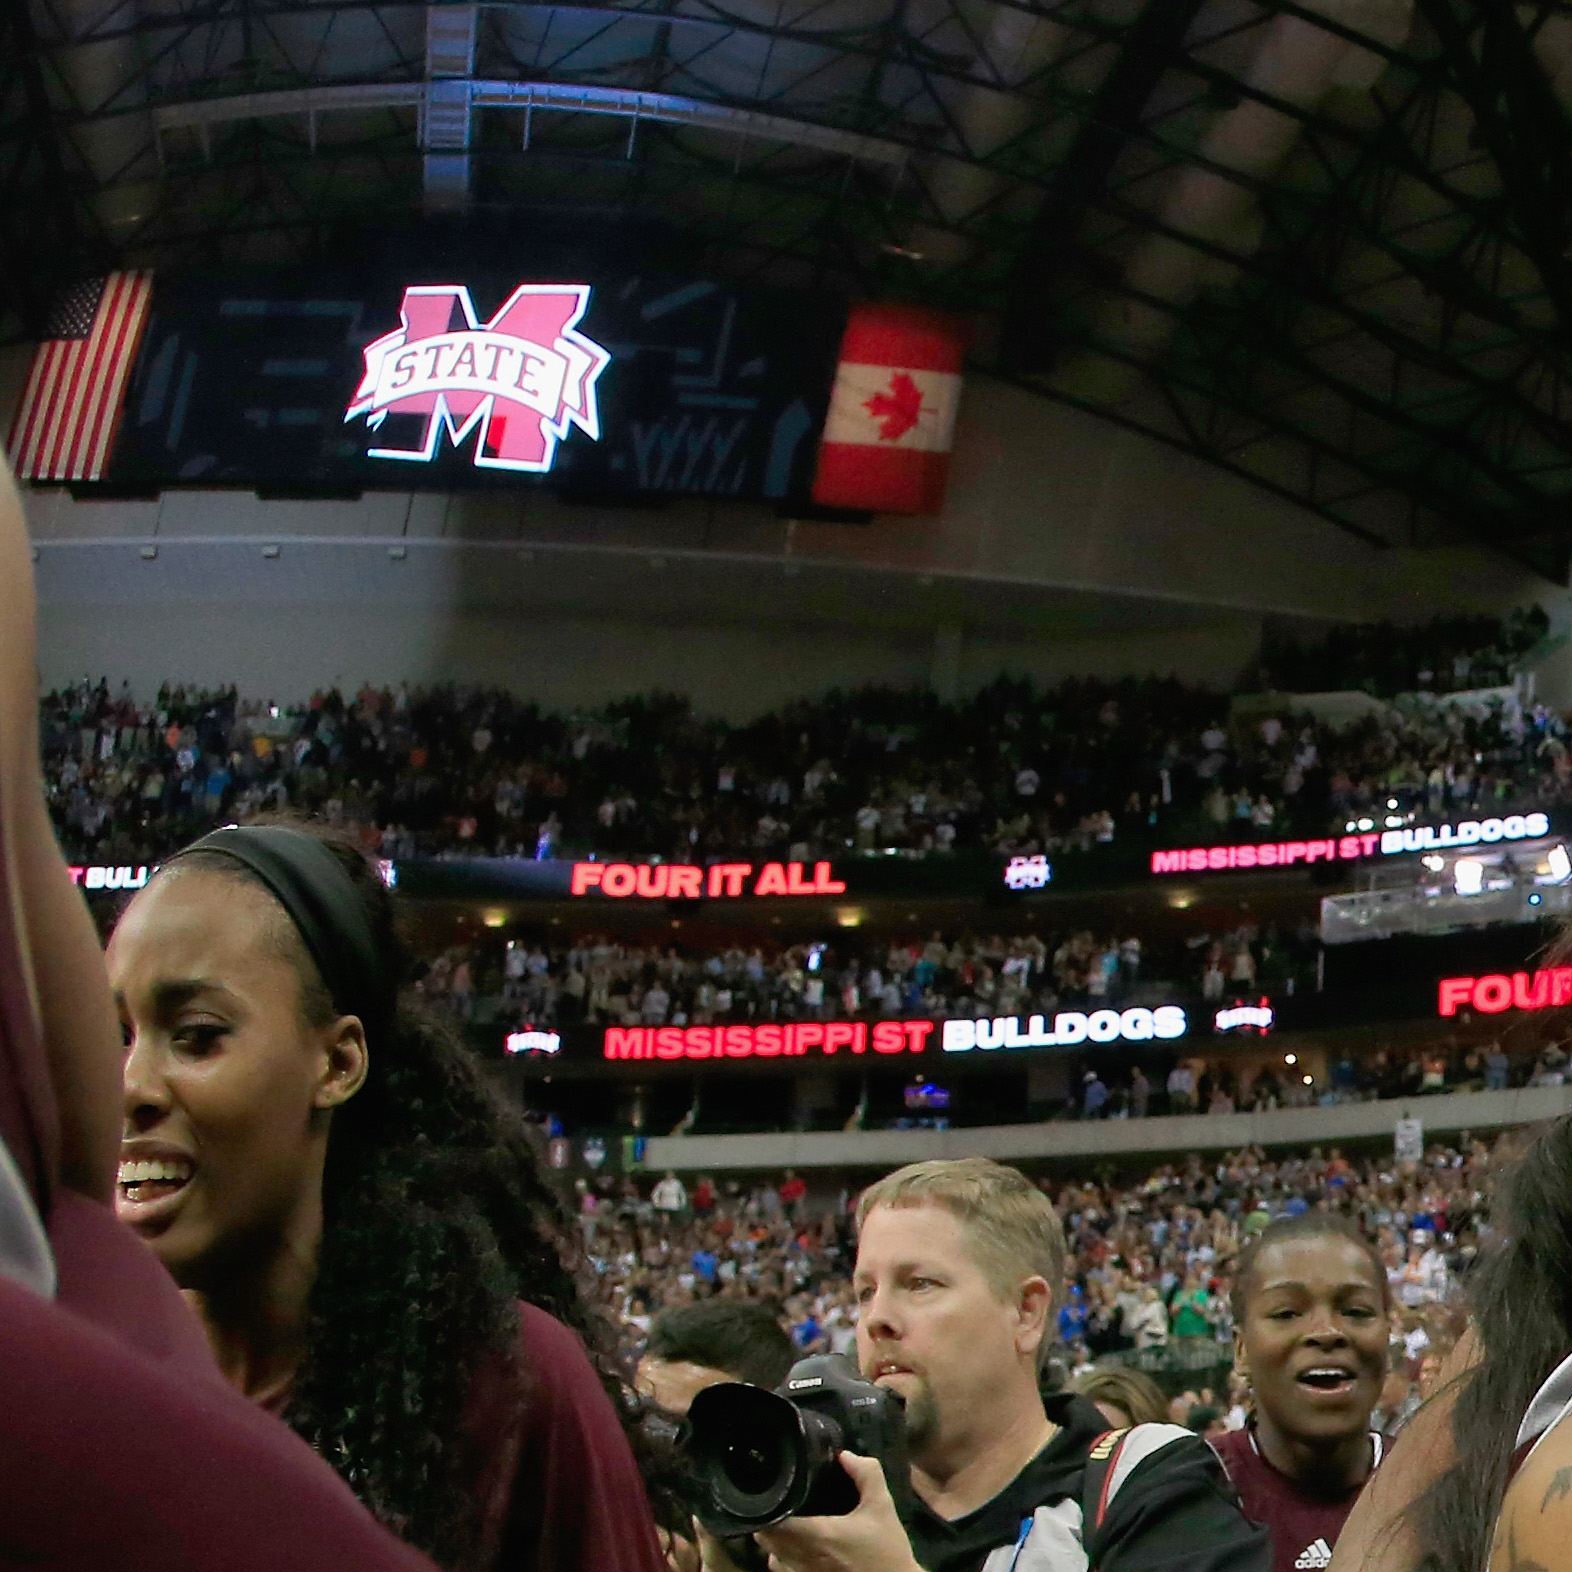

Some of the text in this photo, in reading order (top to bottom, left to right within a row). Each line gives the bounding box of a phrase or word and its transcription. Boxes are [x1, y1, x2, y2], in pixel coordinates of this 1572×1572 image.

[392, 340, 542, 397] STATE
[1151, 813, 1549, 873] MISSISSIPPI ST BULLDOGS
[571, 861, 846, 898] FOUR IT ALL
[604, 1022, 867, 1060] MISSISSIPPI
[873, 1021, 933, 1053] ST
[942, 1005, 1187, 1052] BULLDOGS
